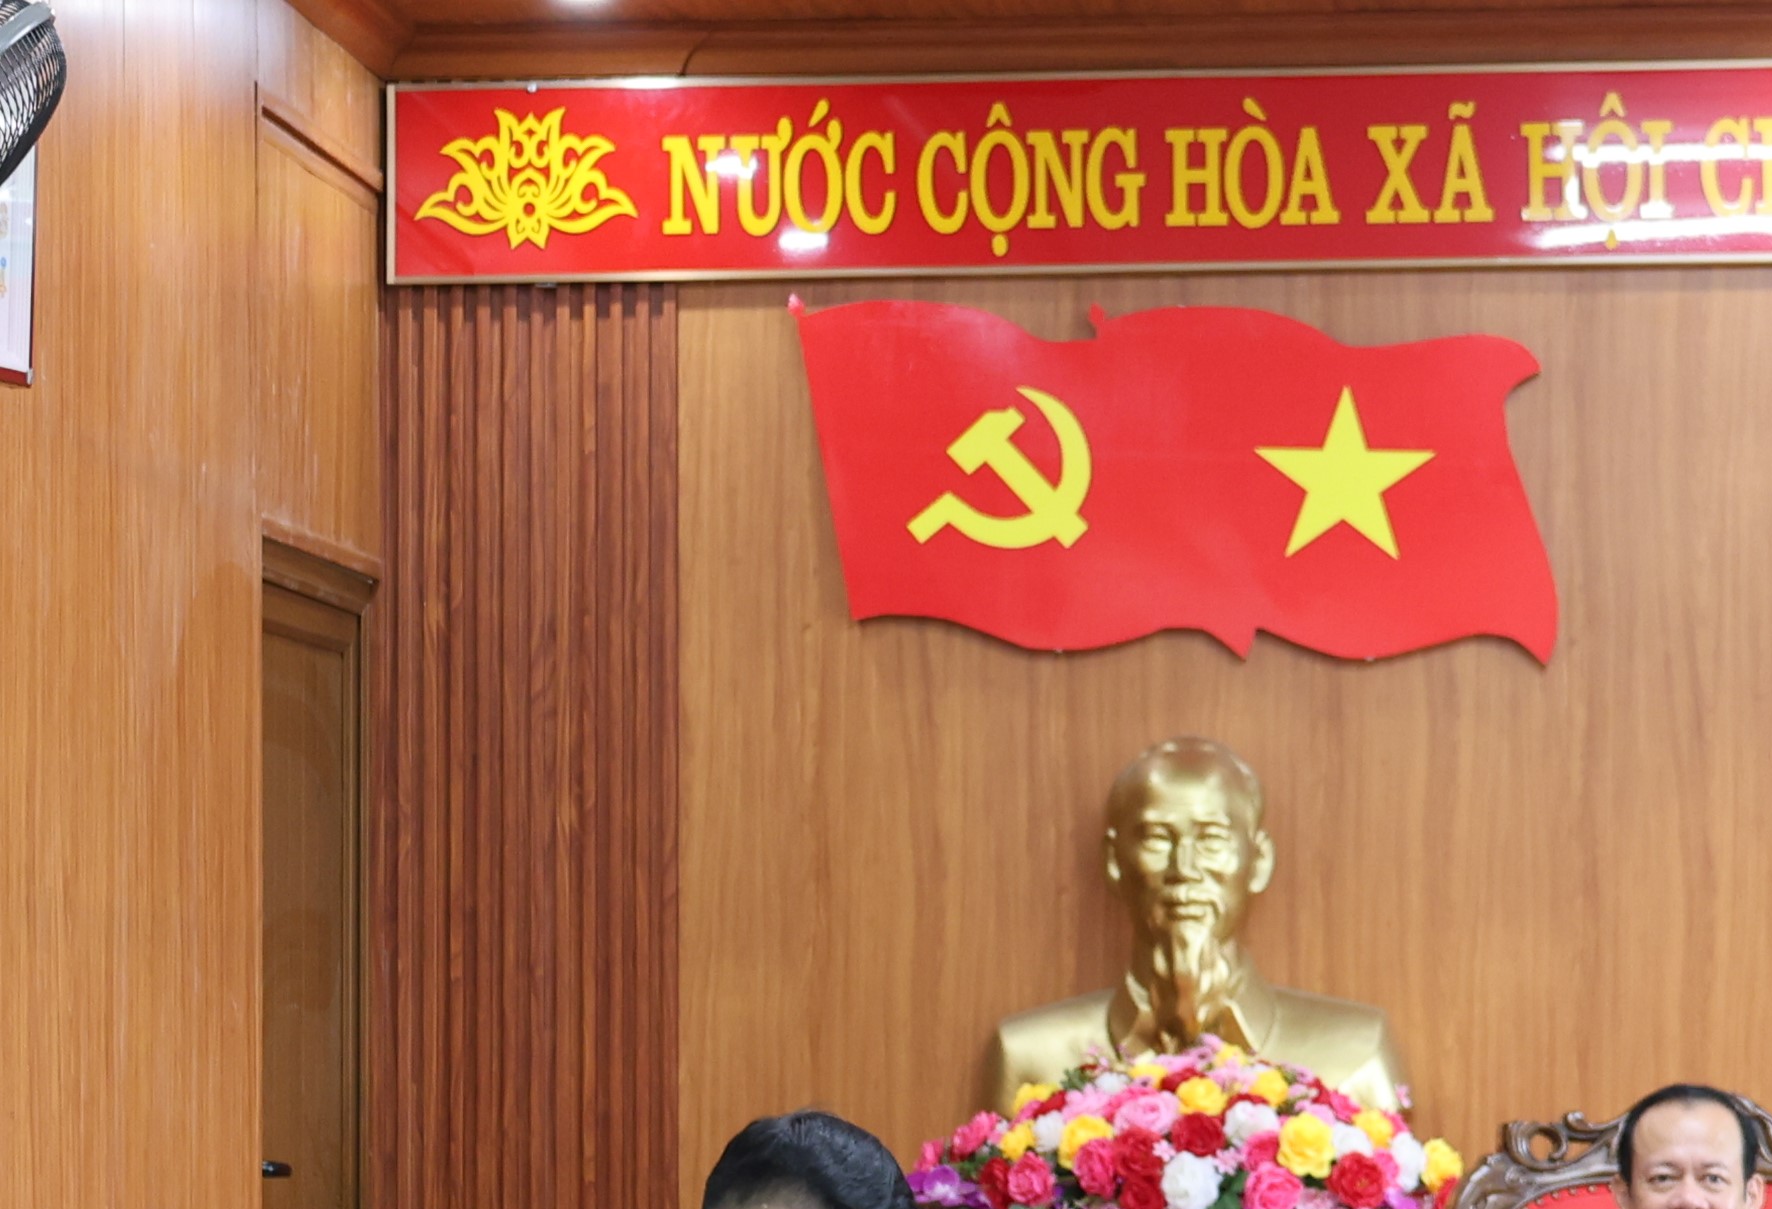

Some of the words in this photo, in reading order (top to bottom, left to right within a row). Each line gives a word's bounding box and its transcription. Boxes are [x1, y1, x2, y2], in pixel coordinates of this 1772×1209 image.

[661, 98, 896, 237] NƯỚC
[917, 102, 1146, 257] CỘNG
[1165, 97, 1341, 230] HÒA
[1366, 102, 1495, 224] XÃ
[1520, 93, 1673, 248] HỘI
